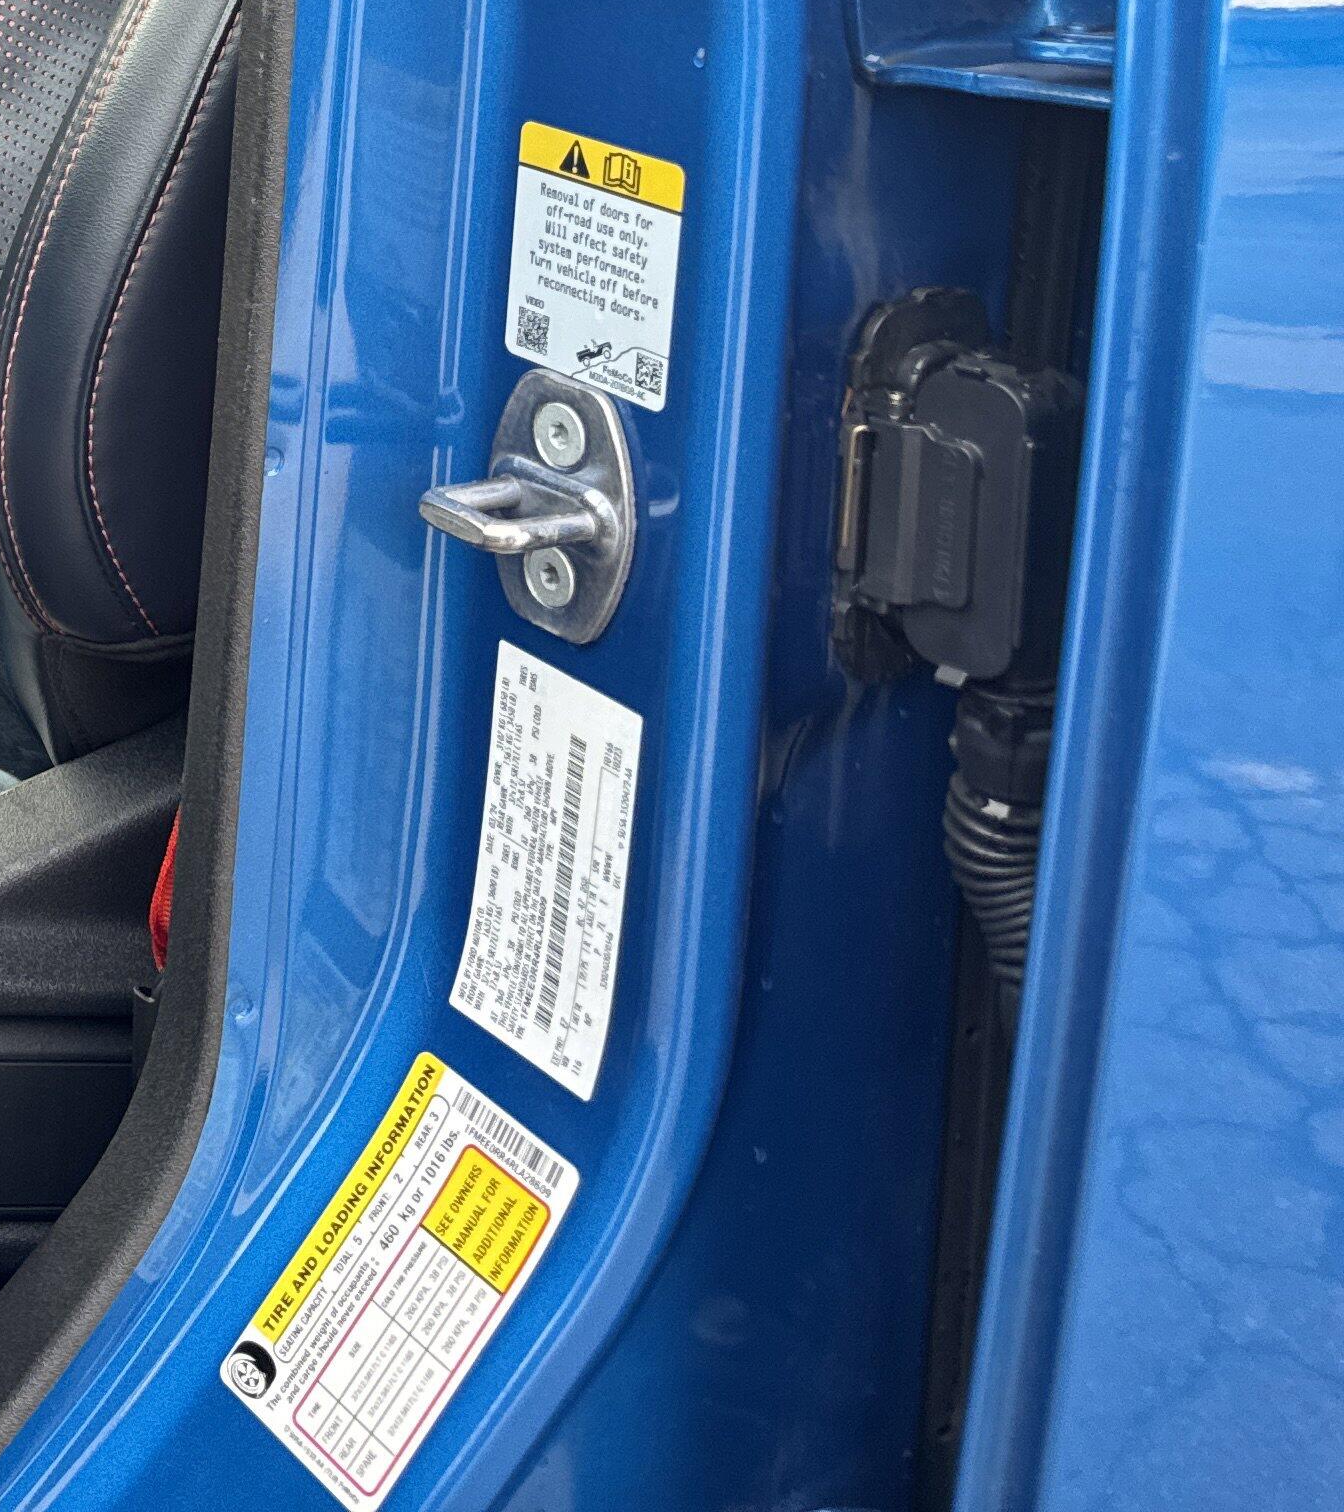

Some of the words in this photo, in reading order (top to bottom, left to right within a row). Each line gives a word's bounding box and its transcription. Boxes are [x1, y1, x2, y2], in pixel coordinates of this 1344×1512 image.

[540, 182, 579, 207] Removal
[583, 198, 595, 212] of
[600, 202, 630, 224] doors
[635, 213, 653, 231] for
[546, 205, 592, 230] off-road
[596, 223, 614, 238] use
[619, 230, 648, 250] only.
[538, 238, 572, 260] system
[576, 252, 645, 284] performance.
[545, 220, 567, 240] Will
[572, 232, 607, 254] affect
[612, 246, 648, 270] safety
[525, 295, 545, 309] VIDEO
[529, 250, 552, 271] Turn
[556, 263, 596, 287] vehicle
[599, 278, 618, 294] off
[622, 284, 659, 310] before
[537, 275, 606, 311] reconnecting
[610, 300, 645, 322] doors.
[466, 946, 478, 968] FORD
[472, 918, 483, 947] MOTOR
[465, 976, 479, 1008] FRONT
[429, 1111, 439, 1122] 3
[262, 1292, 295, 1331] TIRE
[292, 1256, 318, 1293] AND
[315, 1183, 368, 1255] LOADING
[365, 1064, 435, 1181] INFORMATION
[379, 1224, 400, 1250] 460
[397, 1204, 416, 1222] kg
[411, 1187, 424, 1204] or
[421, 1151, 446, 1185] 1016
[440, 1130, 460, 1152] lbs.
[393, 1173, 404, 1184] 2
[434, 1212, 454, 1237] SEE
[449, 1164, 482, 1214] OWNERS
[452, 1205, 487, 1251] MANUAL
[481, 1177, 501, 1203] FOR
[473, 1197, 517, 1264] ADDITIONAL
[333, 1250, 353, 1274] TOTAL
[352, 1235, 363, 1246] 5
[488, 1202, 539, 1281] INFORMATION
[429, 1269, 440, 1282] 38
[436, 1255, 449, 1270] PSI
[446, 1284, 457, 1298] 38
[453, 1270, 466, 1286] PSI
[279, 1324, 304, 1357] SEATING
[300, 1286, 328, 1325] CAPACITY
[465, 1302, 478, 1316] 38
[473, 1288, 487, 1304] PSI
[266, 1393, 282, 1411] The
[280, 1348, 311, 1394] combined
[309, 1317, 332, 1349] weight
[330, 1306, 339, 1319] of
[337, 1261, 370, 1308] occupants
[286, 1384, 301, 1404] and
[298, 1358, 318, 1385] cargo
[316, 1327, 339, 1359] should
[336, 1301, 355, 1328] never
[354, 1267, 378, 1301] exceed
[322, 1415, 343, 1444] FRONT
[338, 1437, 357, 1460] REAR
[355, 1450, 377, 1478] SPARE
